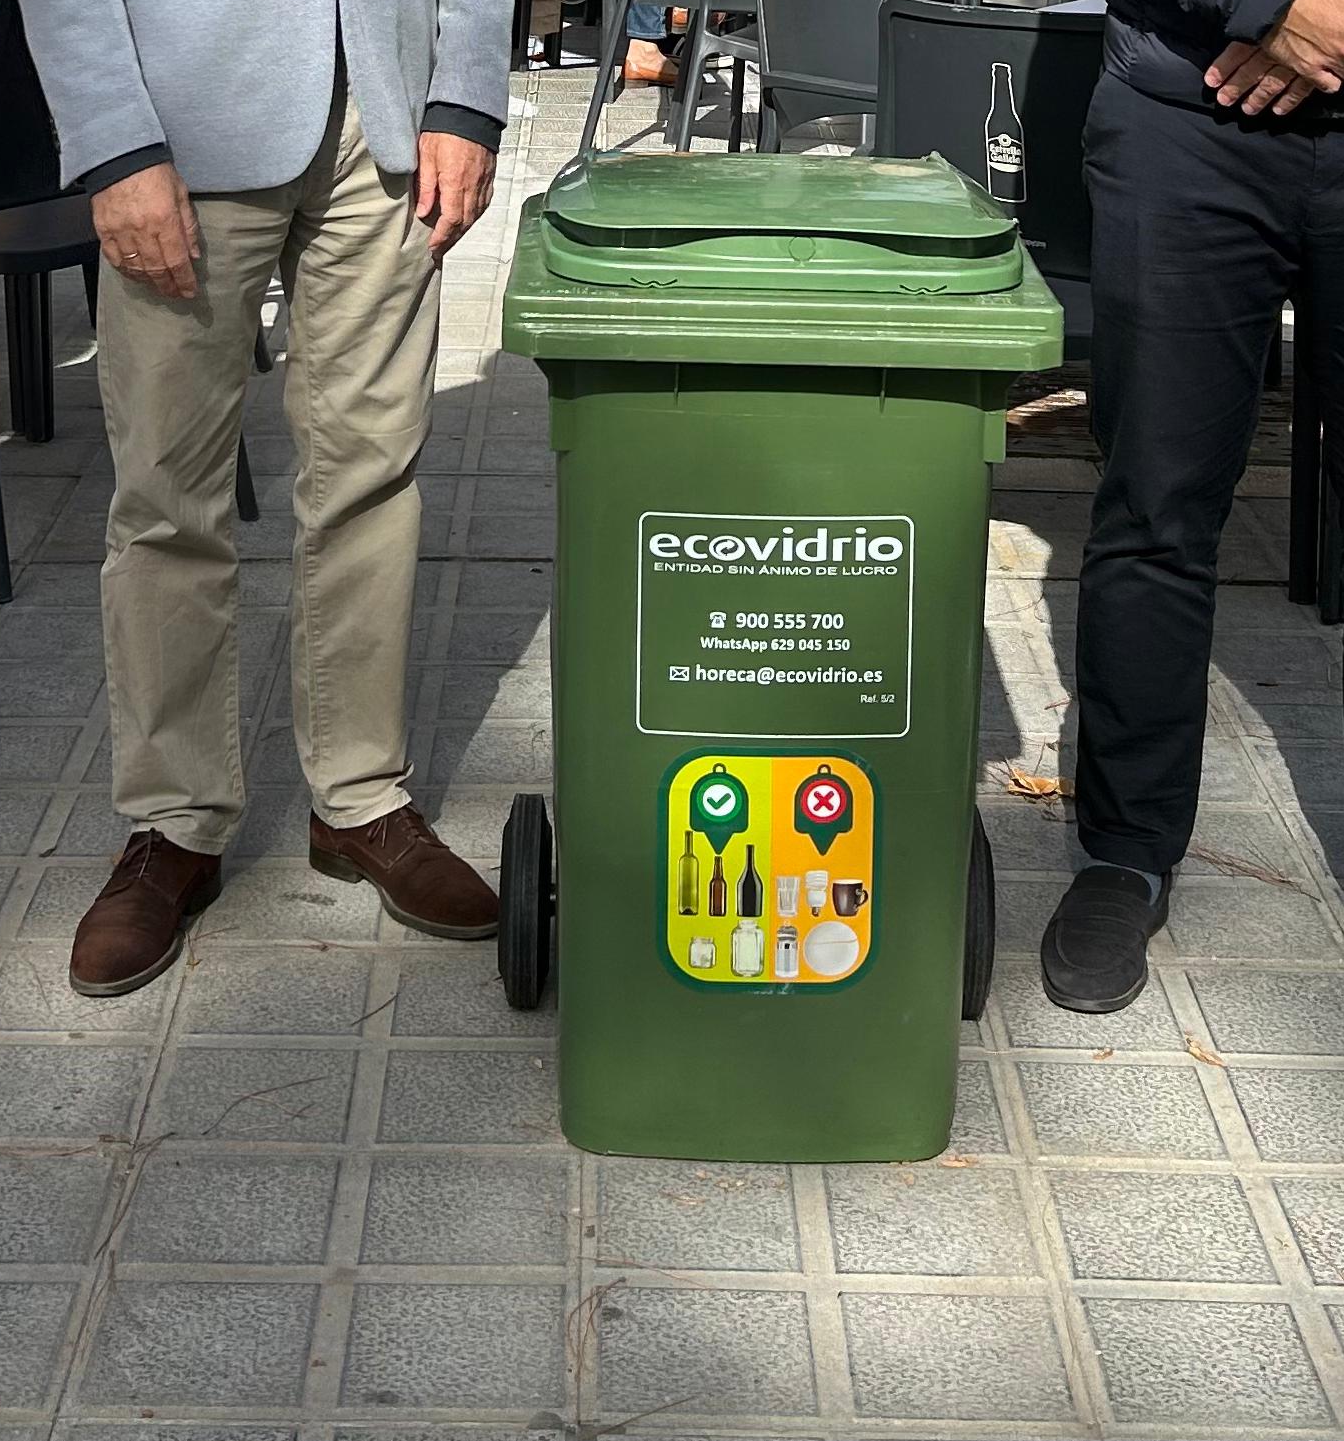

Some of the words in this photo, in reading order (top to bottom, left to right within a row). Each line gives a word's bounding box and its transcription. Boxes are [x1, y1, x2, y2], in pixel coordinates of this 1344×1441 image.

[649, 527, 904, 562] ecovidrio
[653, 561, 724, 574] ENTIDAD
[728, 564, 755, 575] SIN
[815, 565, 838, 576] DE
[842, 565, 898, 576] LUCRO
[735, 612, 769, 629] 900
[773, 613, 806, 630] 555
[811, 613, 845, 630] 700
[700, 636, 768, 652] WhatsApp
[770, 638, 795, 651] 629
[798, 638, 823, 651] 045
[826, 639, 851, 651] 150
[695, 664, 883, 685] horeca@ecovidrio.es
